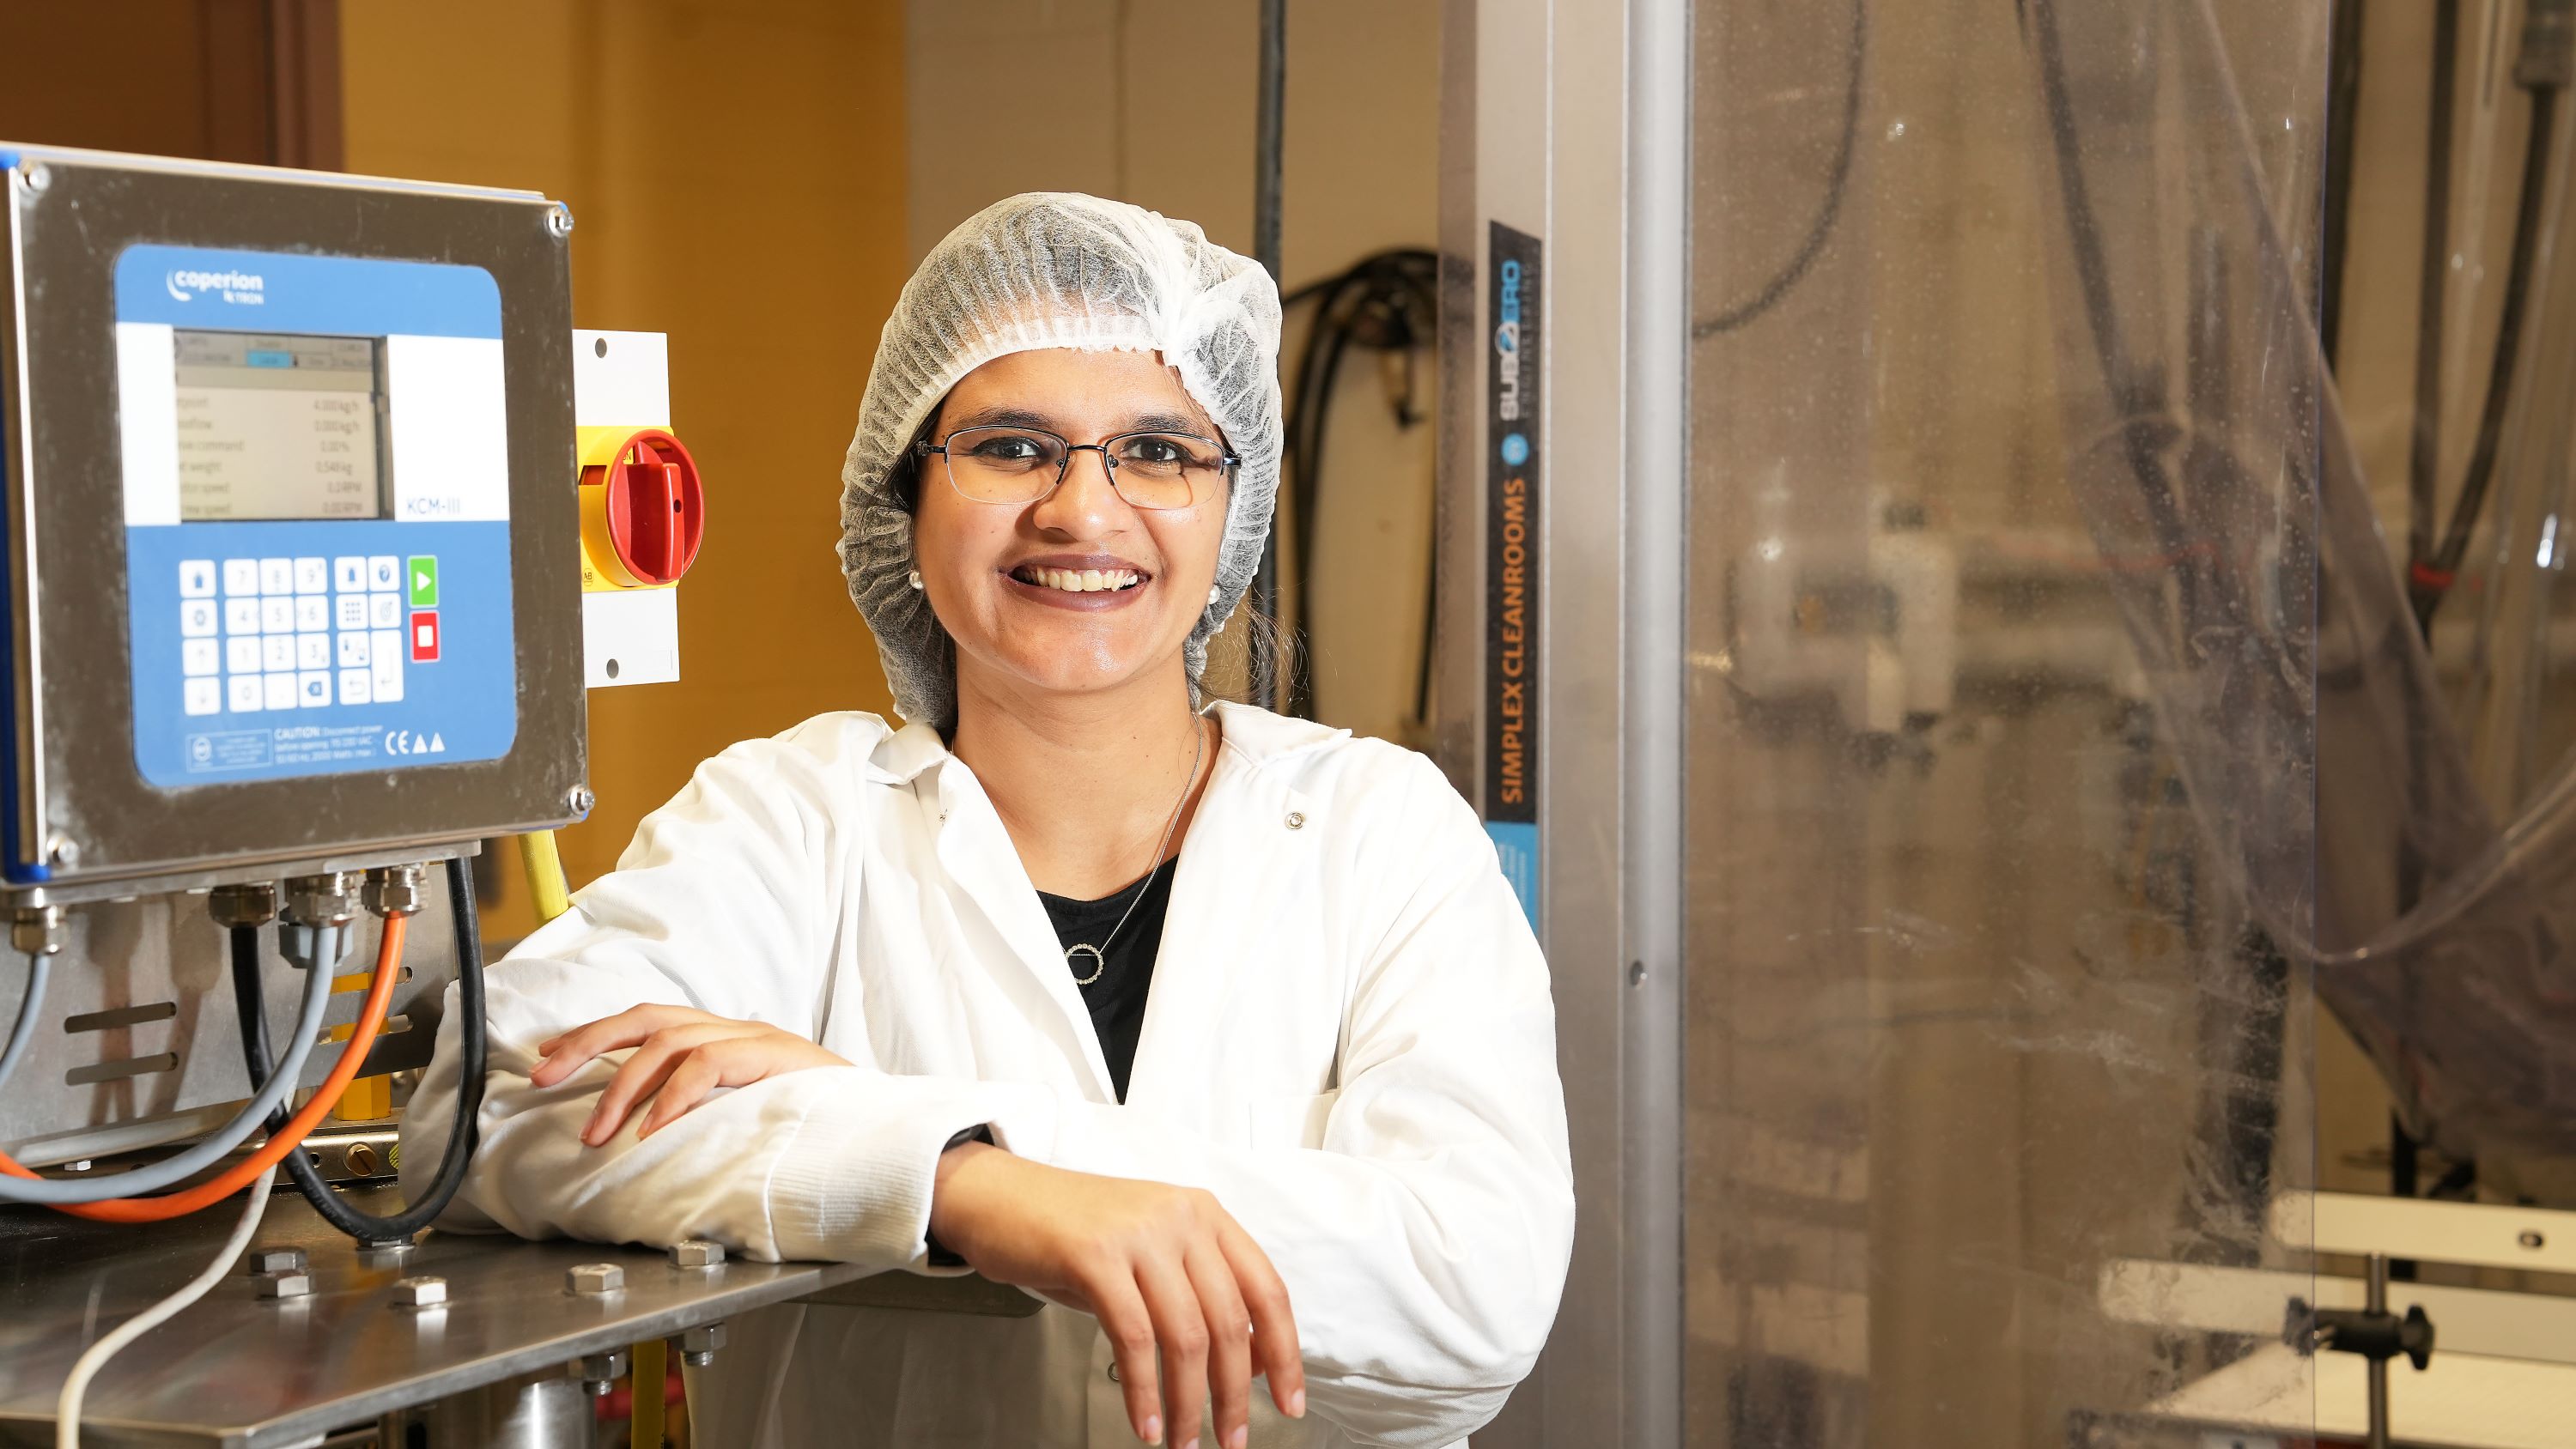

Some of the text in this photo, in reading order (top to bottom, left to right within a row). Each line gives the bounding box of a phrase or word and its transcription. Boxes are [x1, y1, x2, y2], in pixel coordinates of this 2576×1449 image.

[174, 270, 264, 293] coperion
[406, 497, 461, 515] KCM-III
[1503, 477, 1526, 678] CLEANROOMS
[1502, 682, 1524, 804] SIMPLEX
